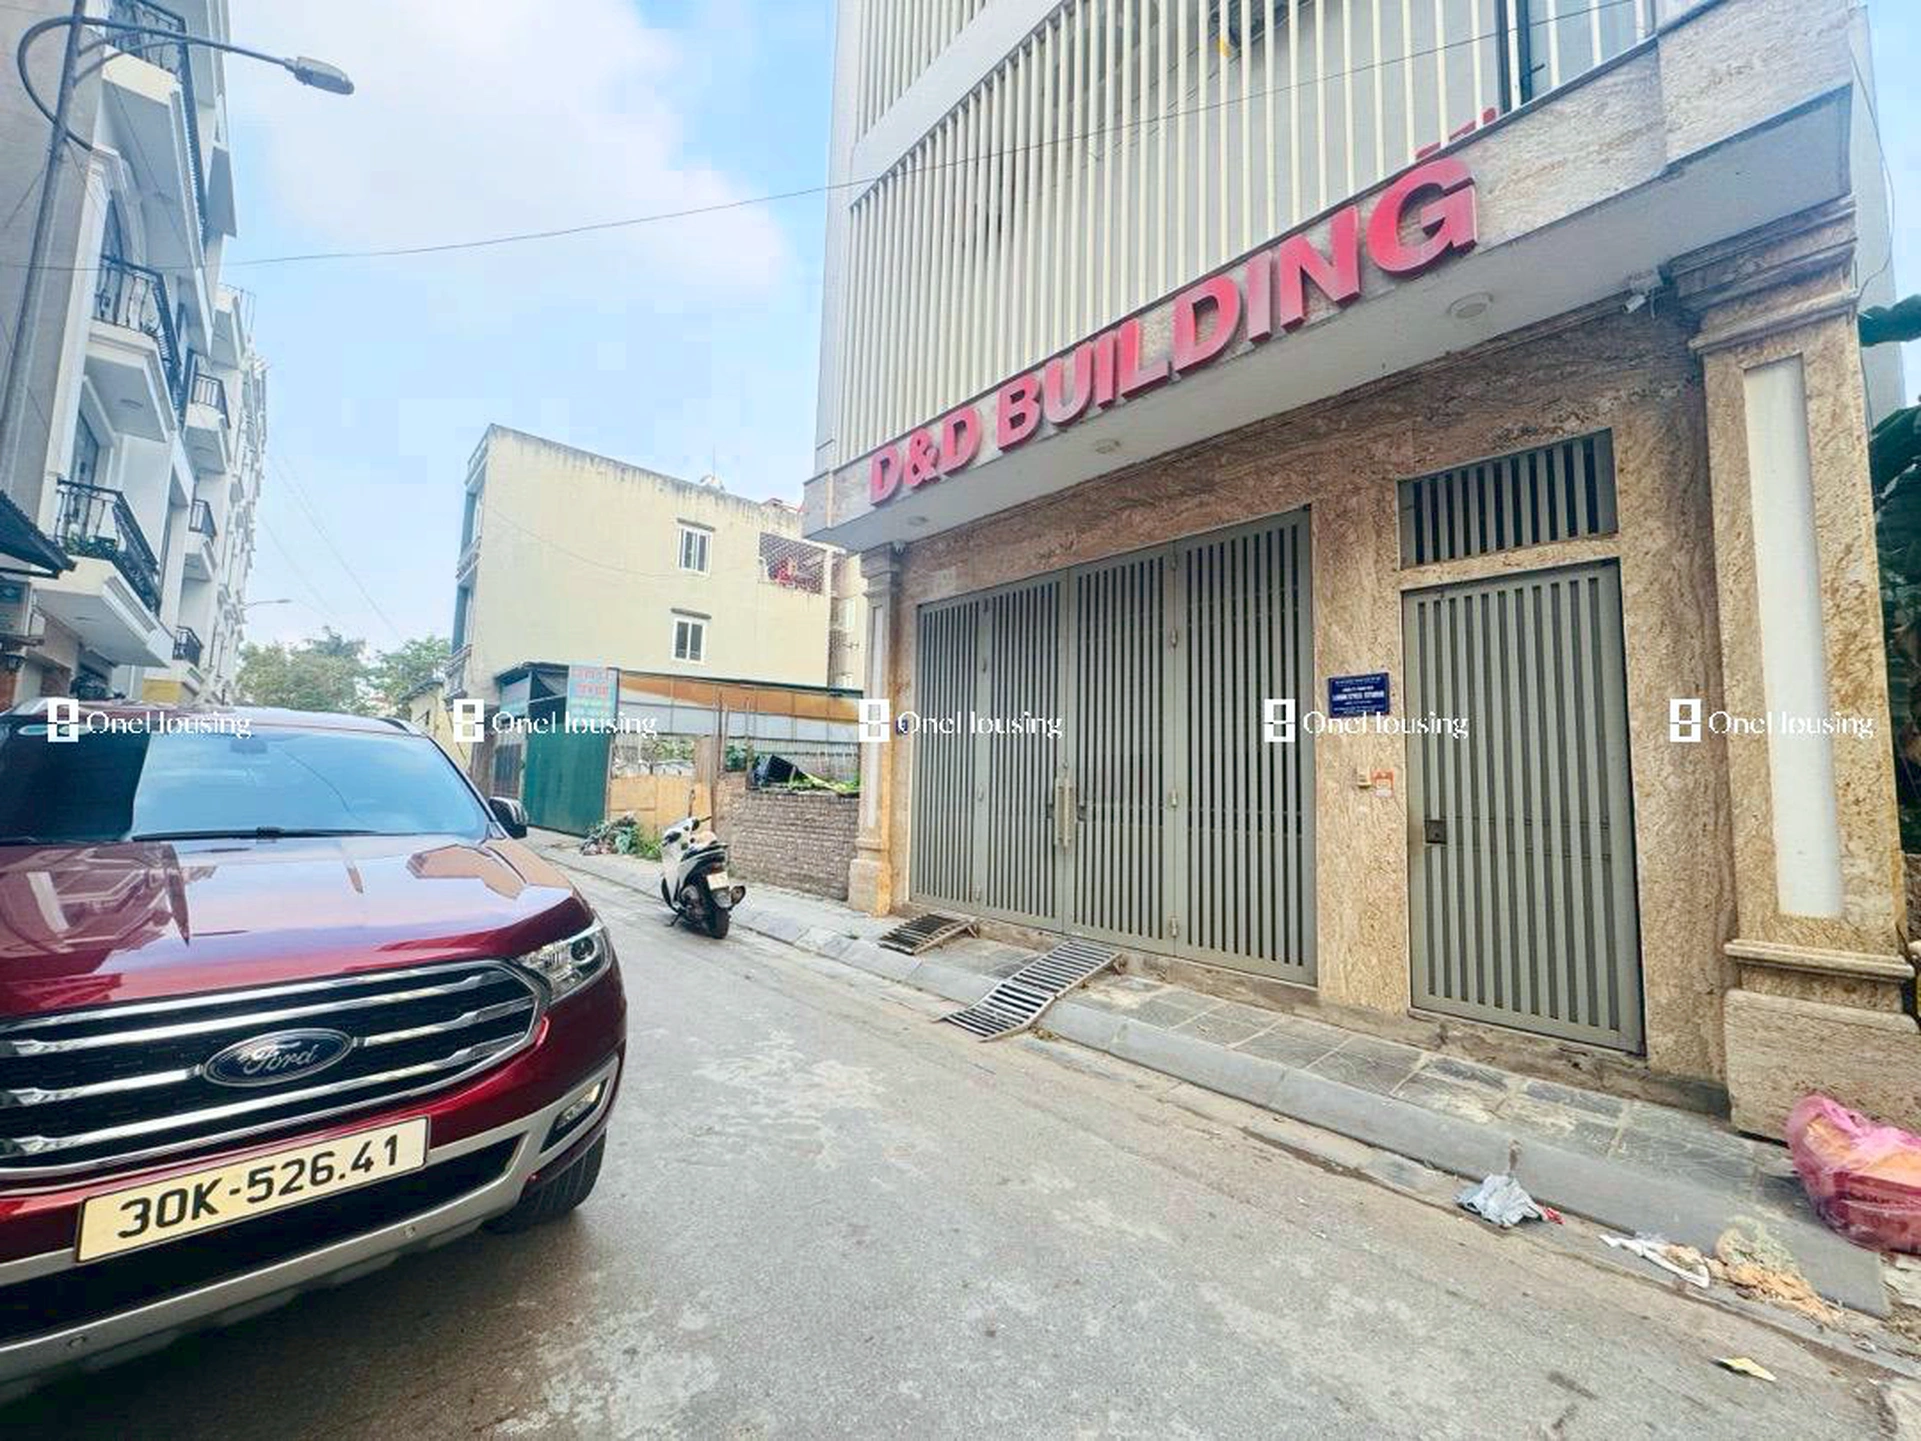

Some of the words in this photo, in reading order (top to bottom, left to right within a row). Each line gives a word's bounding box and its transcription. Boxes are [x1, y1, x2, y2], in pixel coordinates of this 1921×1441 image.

[868, 405, 982, 507] D&D
[995, 157, 1478, 452] BUILDING
[243, 1039, 319, 1075] Ford
[117, 1133, 399, 1239] 30K-526.41
